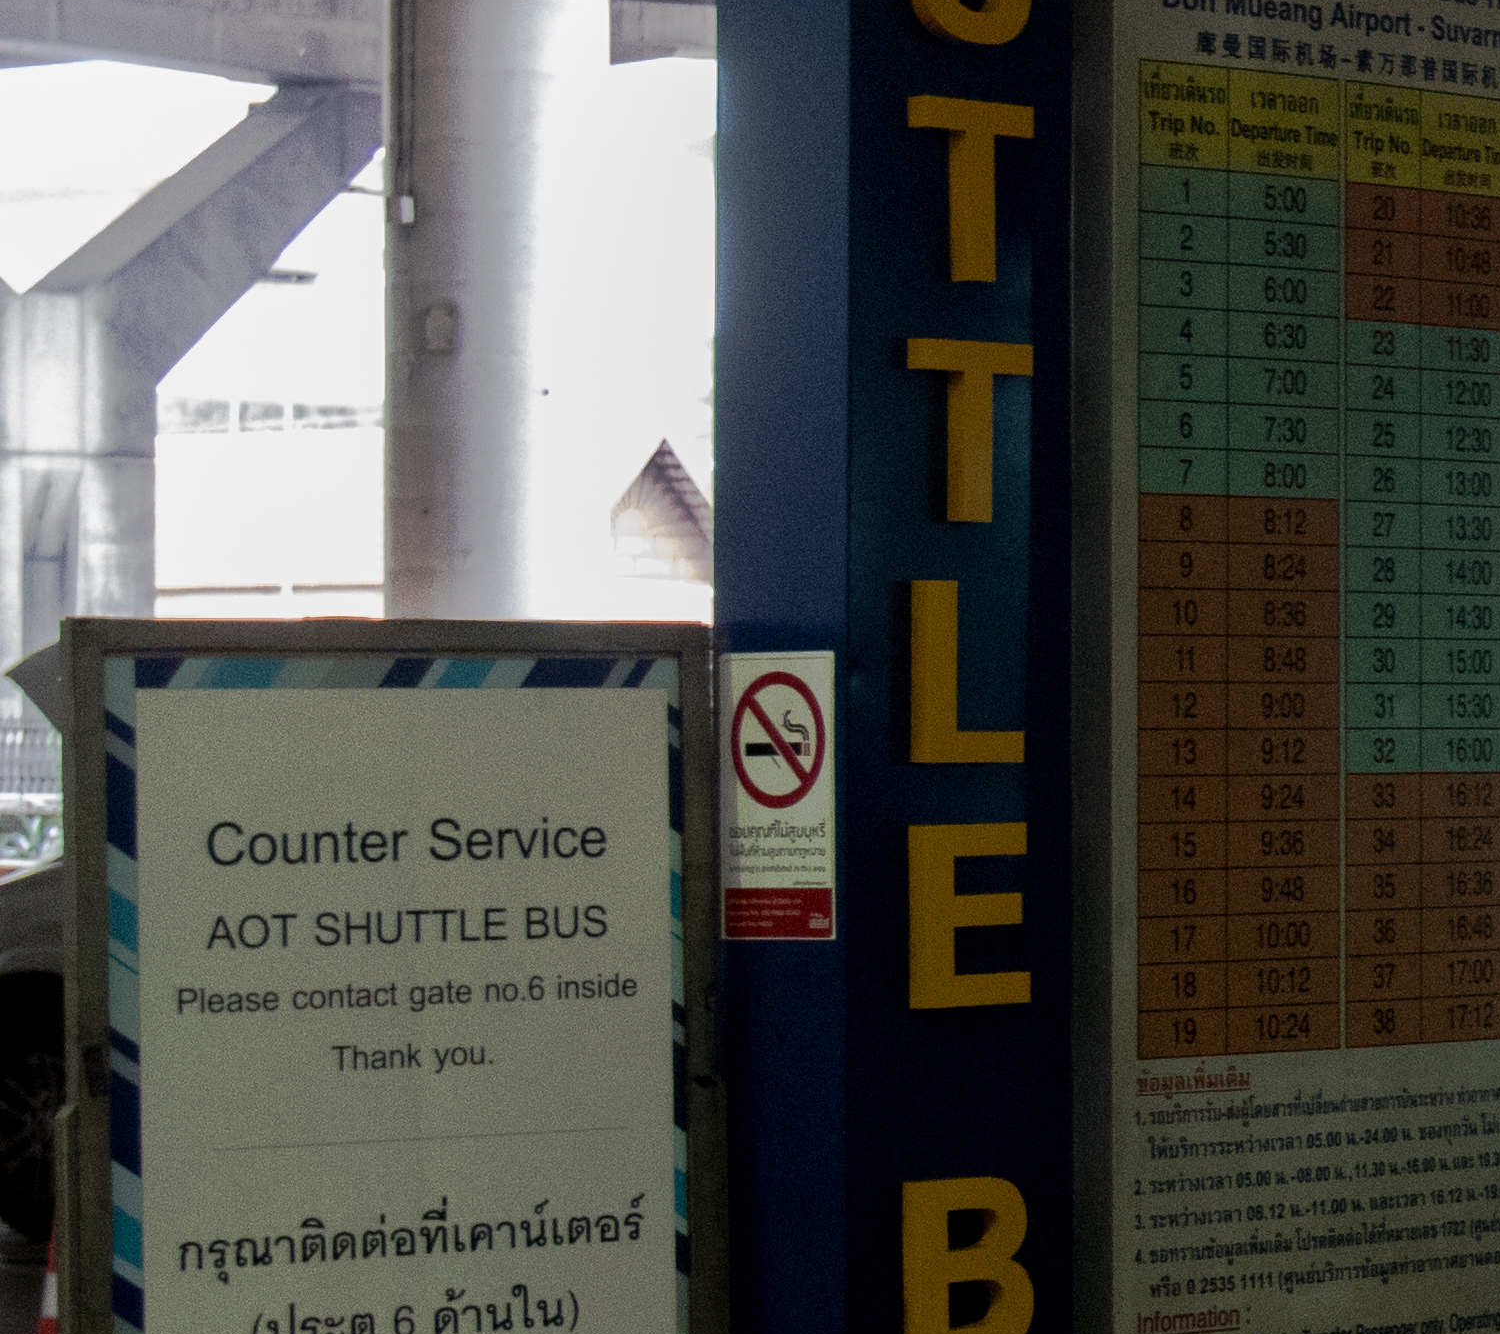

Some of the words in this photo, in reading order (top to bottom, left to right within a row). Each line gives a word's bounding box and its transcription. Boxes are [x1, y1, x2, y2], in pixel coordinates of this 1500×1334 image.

[1330, 2, 1411, 37] Airport
[1148, 110, 1184, 136] Trip
[1191, 115, 1219, 136] No.
[1232, 118, 1301, 143] Departure
[1305, 125, 1339, 147] Time
[1353, 130, 1384, 156] Trip
[1389, 135, 1411, 155] No.
[1422, 138, 1481, 167] Departure
[1182, 179, 1190, 203] 1
[1264, 185, 1306, 213] 5:00
[1372, 195, 1395, 222] 20
[1446, 203, 1490, 231] 10:36
[1180, 227, 1193, 251] 2
[1265, 230, 1307, 259] 5:30
[1372, 242, 1392, 266] 21
[1446, 247, 1491, 275] 10:48
[1180, 271, 1193, 297] 3
[1264, 276, 1307, 305] 6:00
[1372, 287, 1395, 312] 22
[1446, 293, 1490, 319] 11:00
[1179, 318, 1193, 343] 4
[1263, 322, 1307, 350] 6:30
[1371, 330, 1395, 356] 23
[1447, 336, 1490, 363] 11:30
[1180, 366, 1192, 390] 5
[1263, 367, 1307, 396] 7:00
[1372, 374, 1395, 400] 24
[1446, 380, 1491, 407] 12:00
[1179, 412, 1192, 439] 6
[1264, 416, 1307, 444] 7:30
[1179, 459, 1193, 484] 7
[1264, 462, 1306, 489] 8:00
[1180, 505, 1193, 532] 8
[1264, 507, 1307, 535] 8:12
[1180, 552, 1193, 578] 9
[1263, 553, 1307, 581] 8:24
[1172, 599, 1198, 627] 10
[1263, 600, 1306, 628] 8:36
[1176, 646, 1194, 672] 11
[1263, 646, 1306, 673] 8:48
[1172, 695, 1197, 719] 12
[1261, 692, 1305, 720] 9:00
[1172, 738, 1197, 765] 13
[1261, 738, 1305, 765] 9:12
[1172, 786, 1196, 810] 14
[1260, 786, 1305, 811] 9:24
[207, 821, 408, 866] Counter
[429, 817, 606, 861] Service
[1171, 831, 1197, 858] 15
[1260, 830, 1304, 856] 9:36
[1171, 878, 1197, 905] 16
[1261, 875, 1304, 903] 9:48
[207, 916, 294, 949] AOT
[315, 908, 507, 947] SHUTTLE
[526, 905, 608, 940] BUS
[1171, 928, 1197, 952] 17
[1256, 924, 1311, 949] 10:00
[177, 988, 279, 1015] Please
[292, 983, 398, 1010] contact
[409, 981, 472, 1012] gate
[485, 975, 545, 1002] no.6
[557, 973, 637, 999] inside
[1172, 972, 1196, 998] 18
[1256, 971, 1310, 995] 10:12
[1173, 1021, 1197, 1045] 19
[1256, 1016, 1310, 1041] 10:24
[331, 1043, 421, 1071] Thank
[433, 1046, 493, 1074] you.
[179, 1193, 645, 1287] กรุณาติดต่อที่เคาน์เตอร์
[434, 1284, 579, 1334] ด้านใน)
